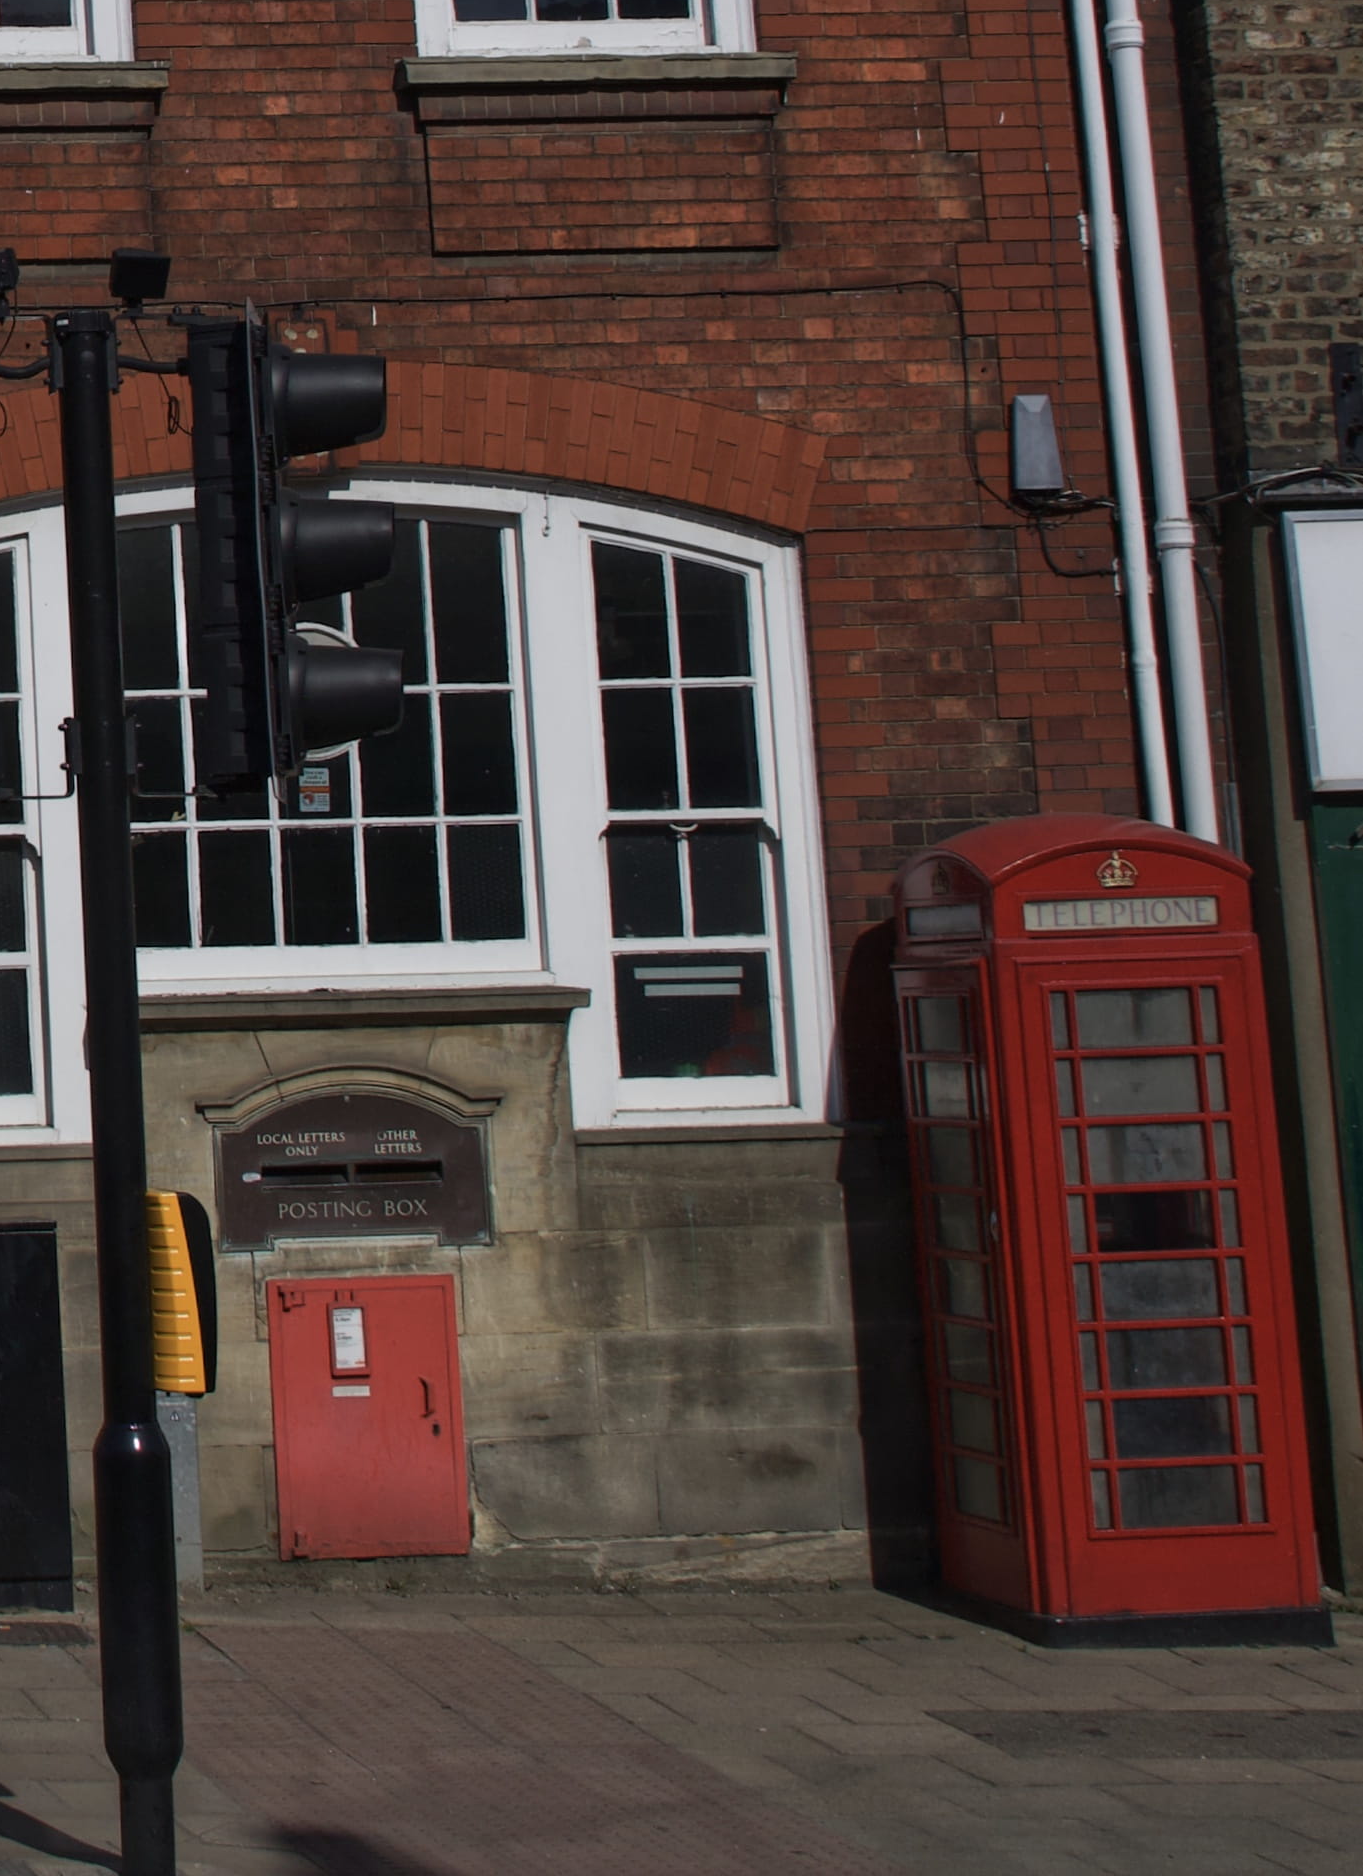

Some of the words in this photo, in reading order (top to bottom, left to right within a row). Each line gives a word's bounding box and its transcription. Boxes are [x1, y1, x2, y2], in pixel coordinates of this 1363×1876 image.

[1032, 898, 1211, 927] TELEPHONE
[257, 1134, 294, 1145] LOCAL
[298, 1132, 346, 1143] LETTERS
[377, 1130, 418, 1141] OTHER
[285, 1146, 319, 1156] ONLY
[374, 1143, 423, 1155] LETTERS
[278, 1201, 373, 1220] POSTING
[383, 1199, 429, 1217] BOX
